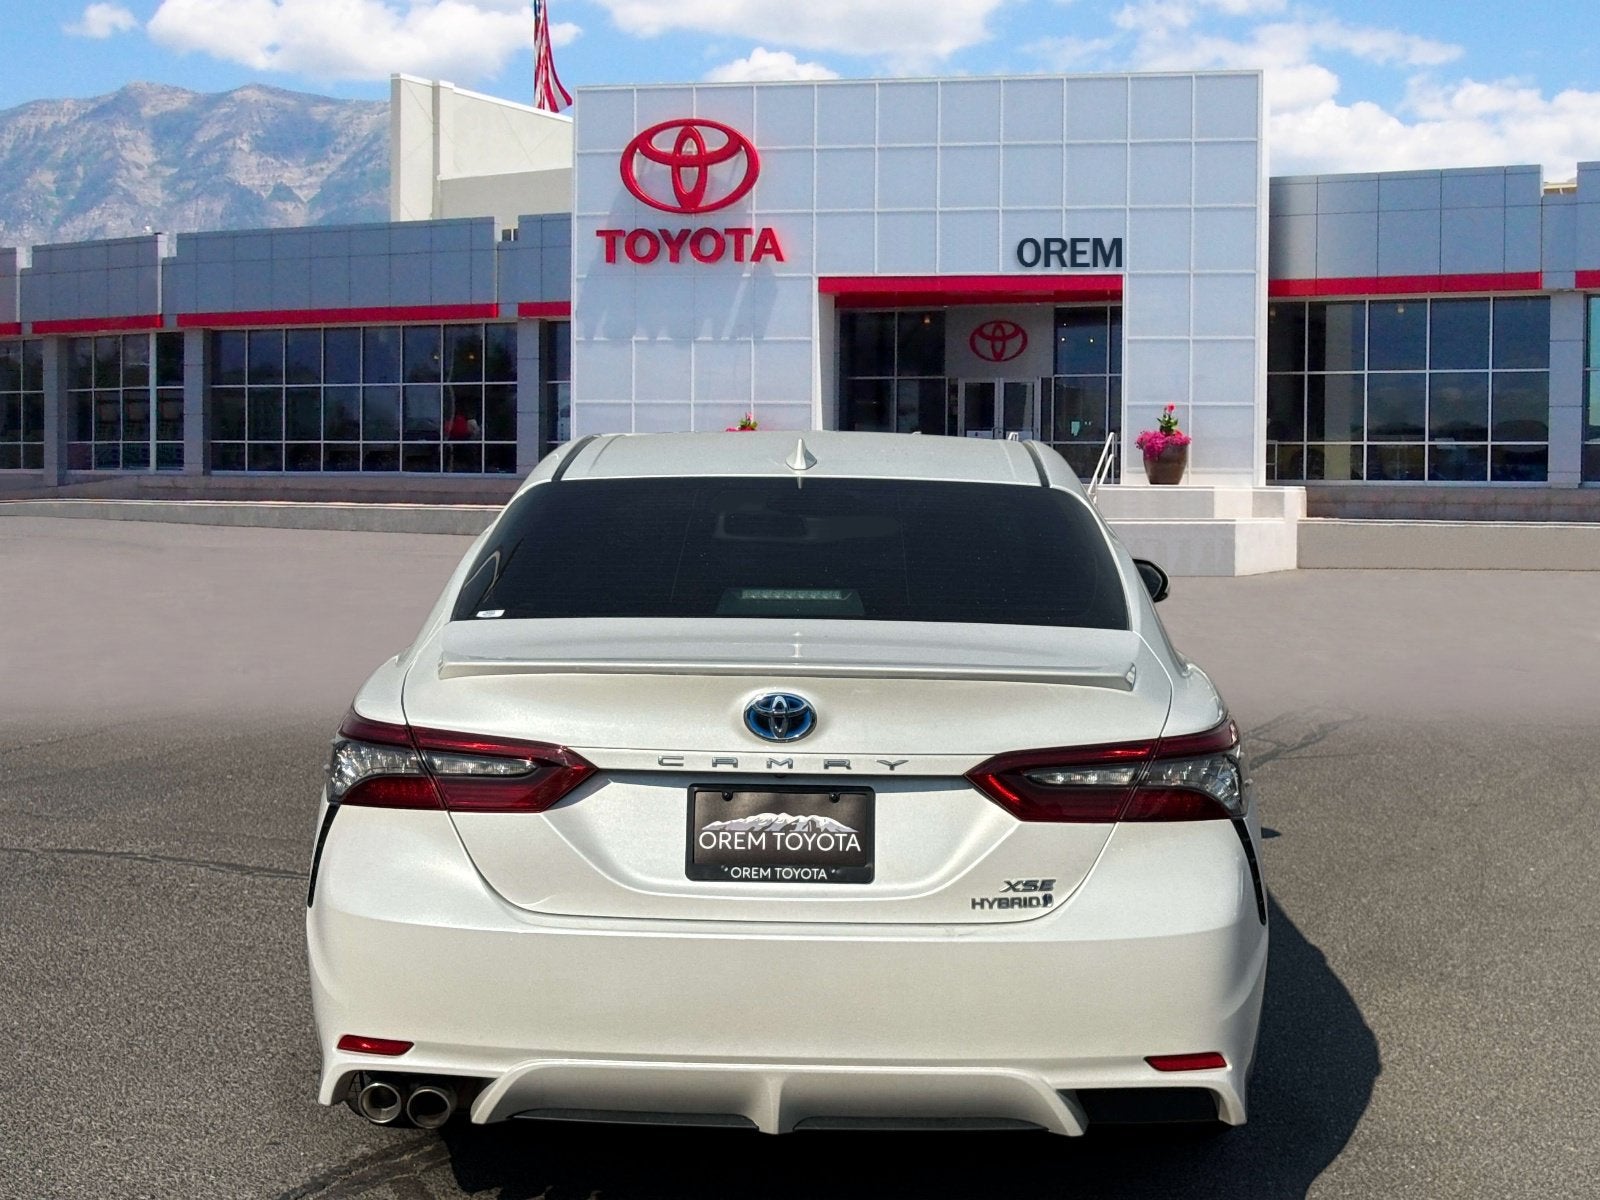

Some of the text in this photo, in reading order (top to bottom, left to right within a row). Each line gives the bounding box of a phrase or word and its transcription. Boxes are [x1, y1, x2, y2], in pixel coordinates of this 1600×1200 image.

[596, 227, 785, 264] TOYOTA
[1016, 237, 1123, 268] OREM
[657, 755, 909, 770] CAMRY
[698, 831, 861, 852] OREM TOYOTA
[730, 867, 828, 880] OREM TOYOTA
[1000, 879, 1057, 893] XSE
[971, 896, 1041, 910] HYBRID
